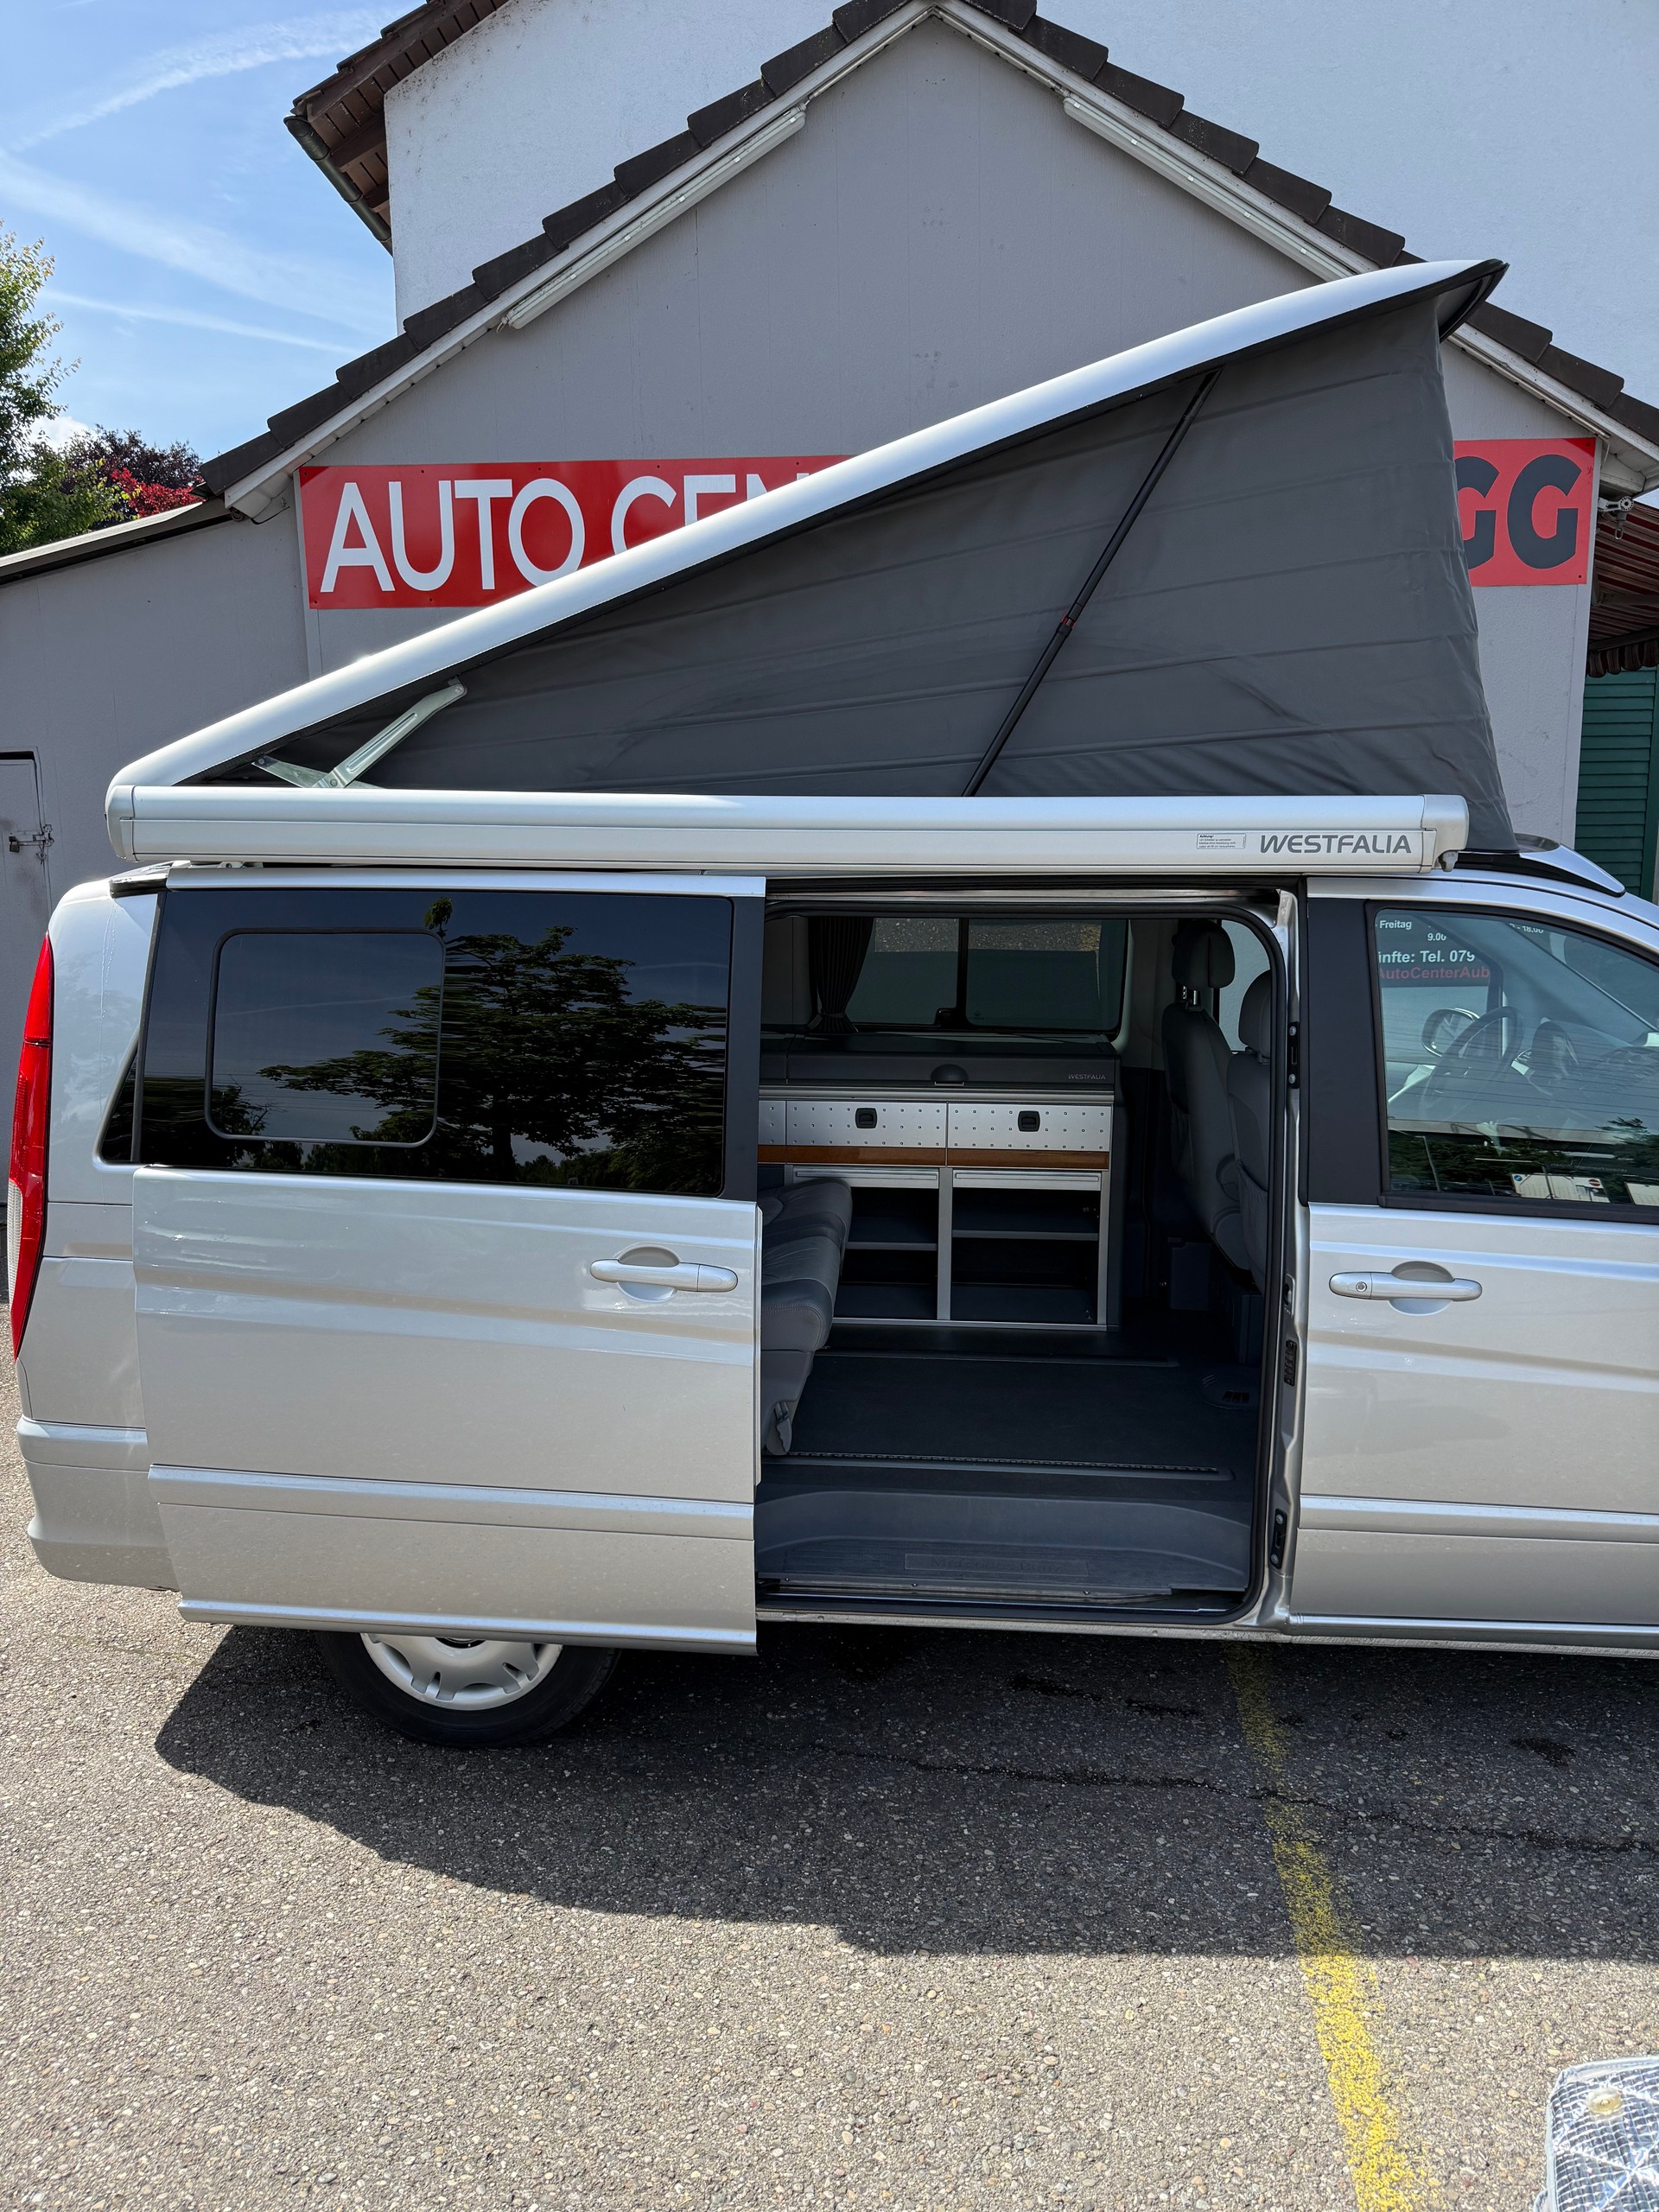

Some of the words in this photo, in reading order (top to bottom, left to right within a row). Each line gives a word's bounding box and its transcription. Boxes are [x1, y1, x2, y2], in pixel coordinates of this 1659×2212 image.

[320, 478, 586, 593] AUTO
[1260, 835, 1412, 854] WESTFALIA
[1379, 920, 1412, 930] Freitag
[1420, 950, 1445, 963] Tel.
